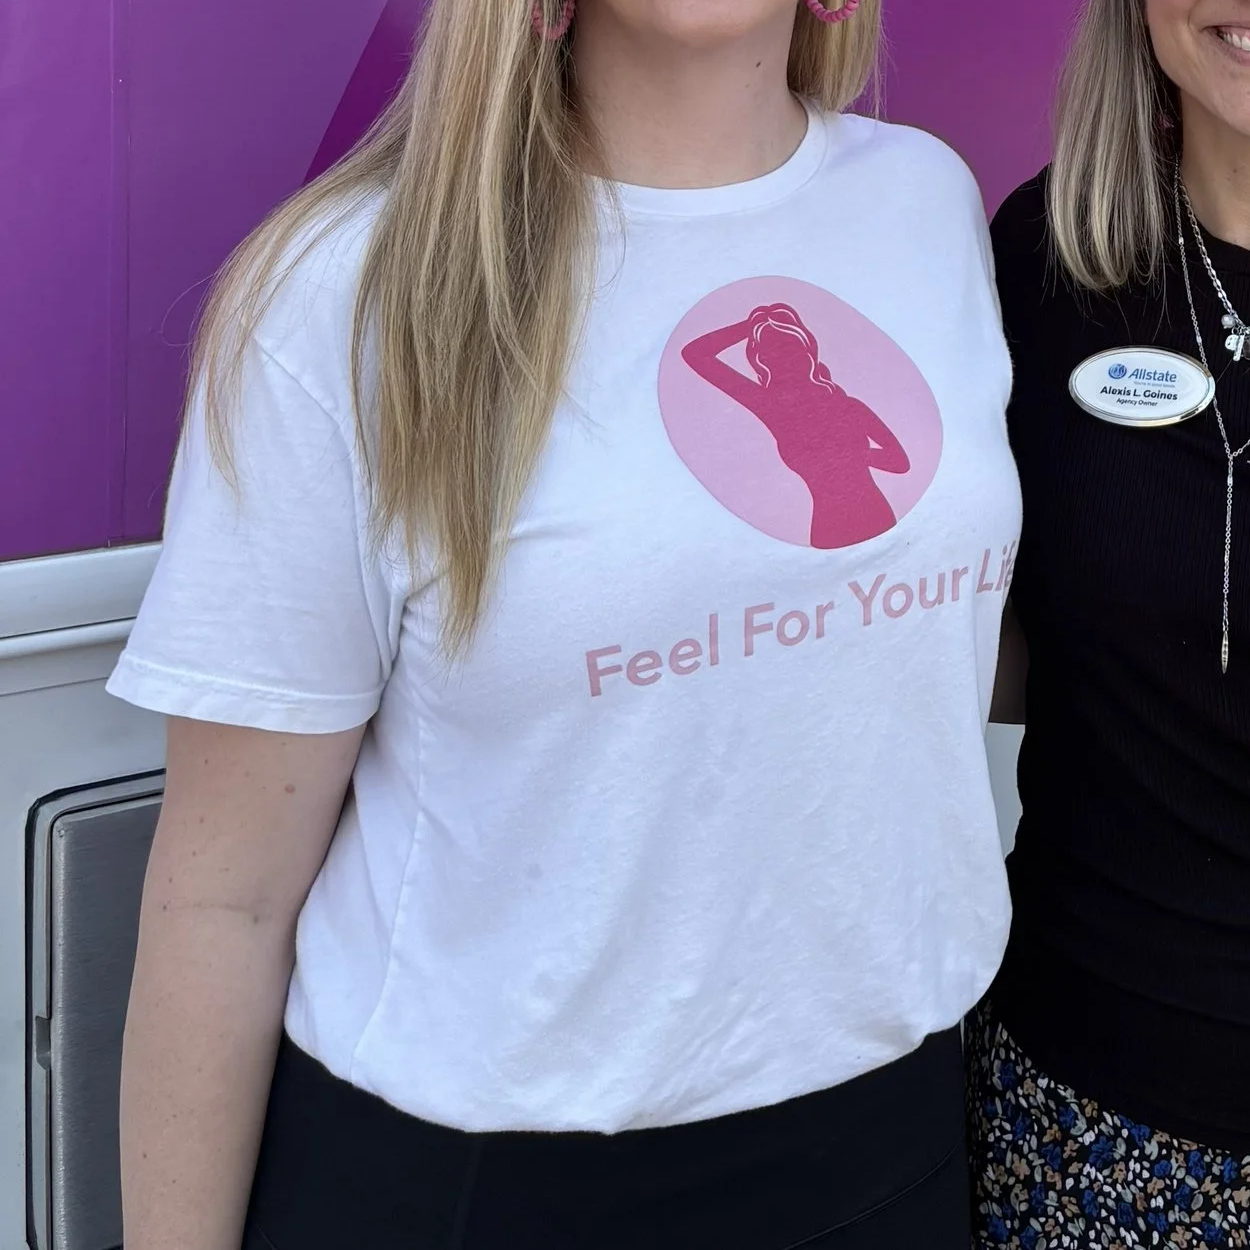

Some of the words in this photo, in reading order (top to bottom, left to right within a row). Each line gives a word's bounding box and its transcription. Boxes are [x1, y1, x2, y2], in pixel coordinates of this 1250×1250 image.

[1128, 368, 1177, 383] Allstate
[1100, 385, 1131, 397] Alexis
[1133, 388, 1141, 398] L.
[1143, 389, 1178, 401] Goines
[1116, 397, 1138, 407] Agency
[1138, 399, 1158, 407] Owner
[585, 613, 720, 698] Feel
[743, 602, 836, 657] For
[847, 565, 969, 627] Your
